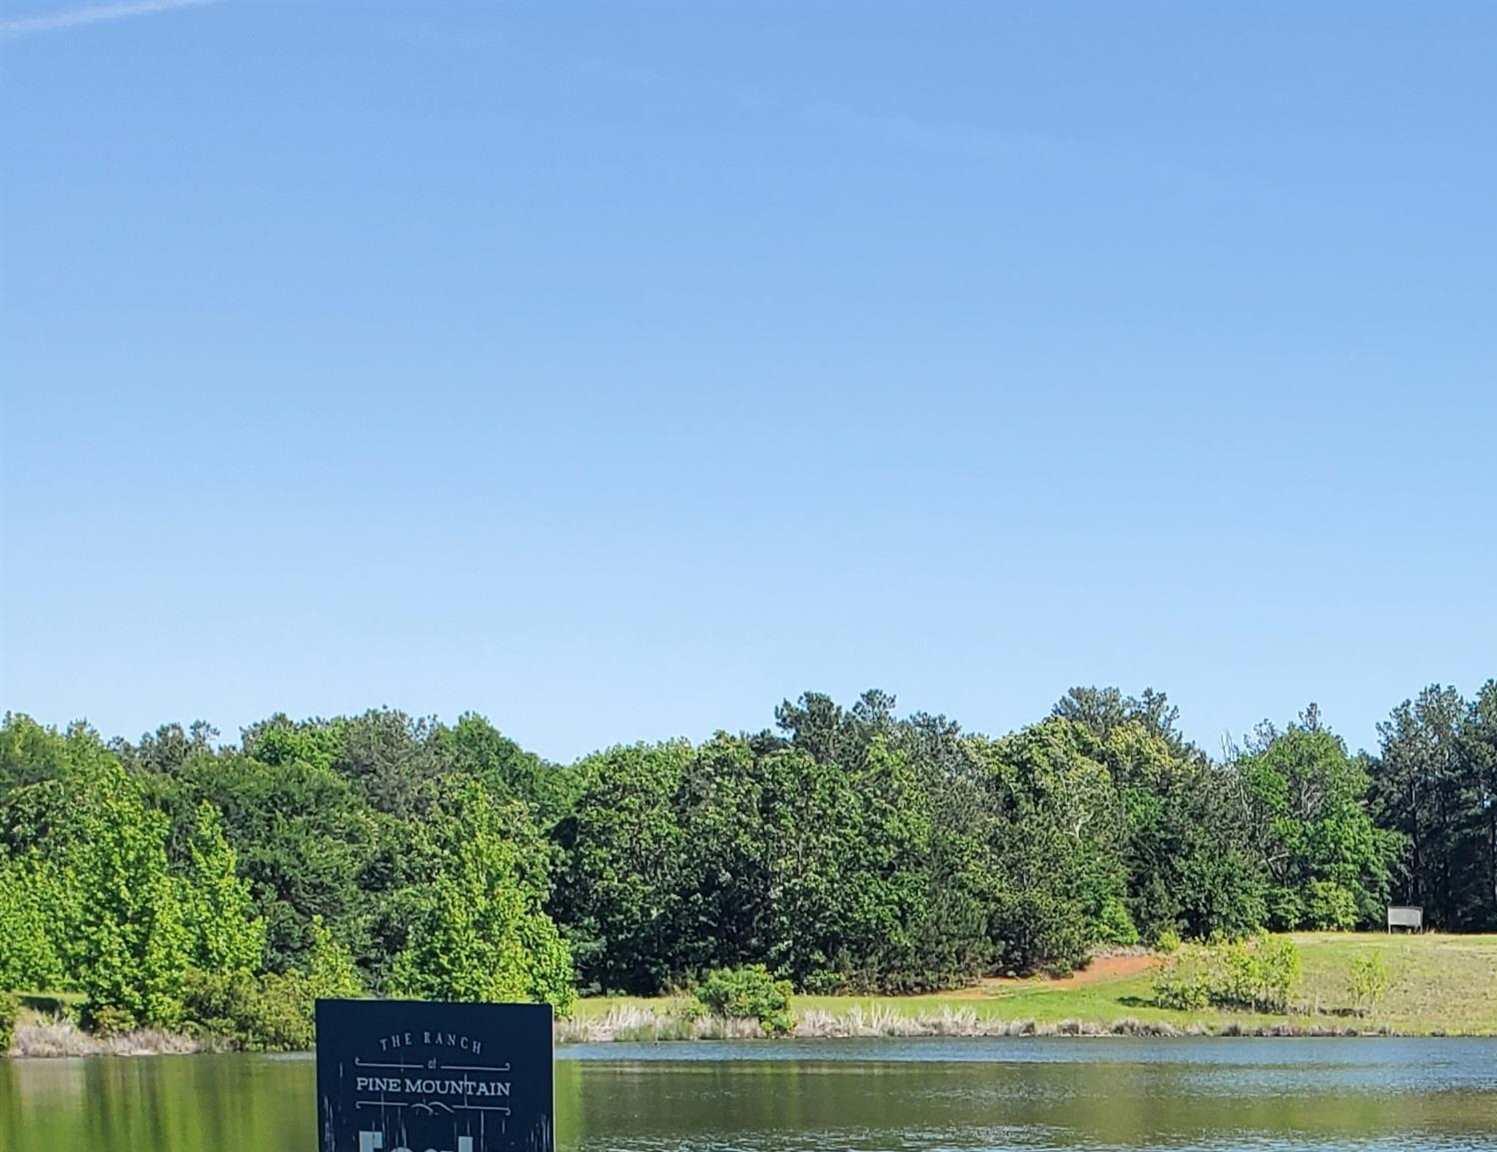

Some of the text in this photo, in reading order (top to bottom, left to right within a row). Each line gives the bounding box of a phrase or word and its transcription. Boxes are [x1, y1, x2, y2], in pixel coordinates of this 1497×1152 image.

[379, 1031, 481, 1054] THE RANCH
[427, 1057, 437, 1070] of
[356, 1077, 511, 1096] PINE MOUNTAIN
